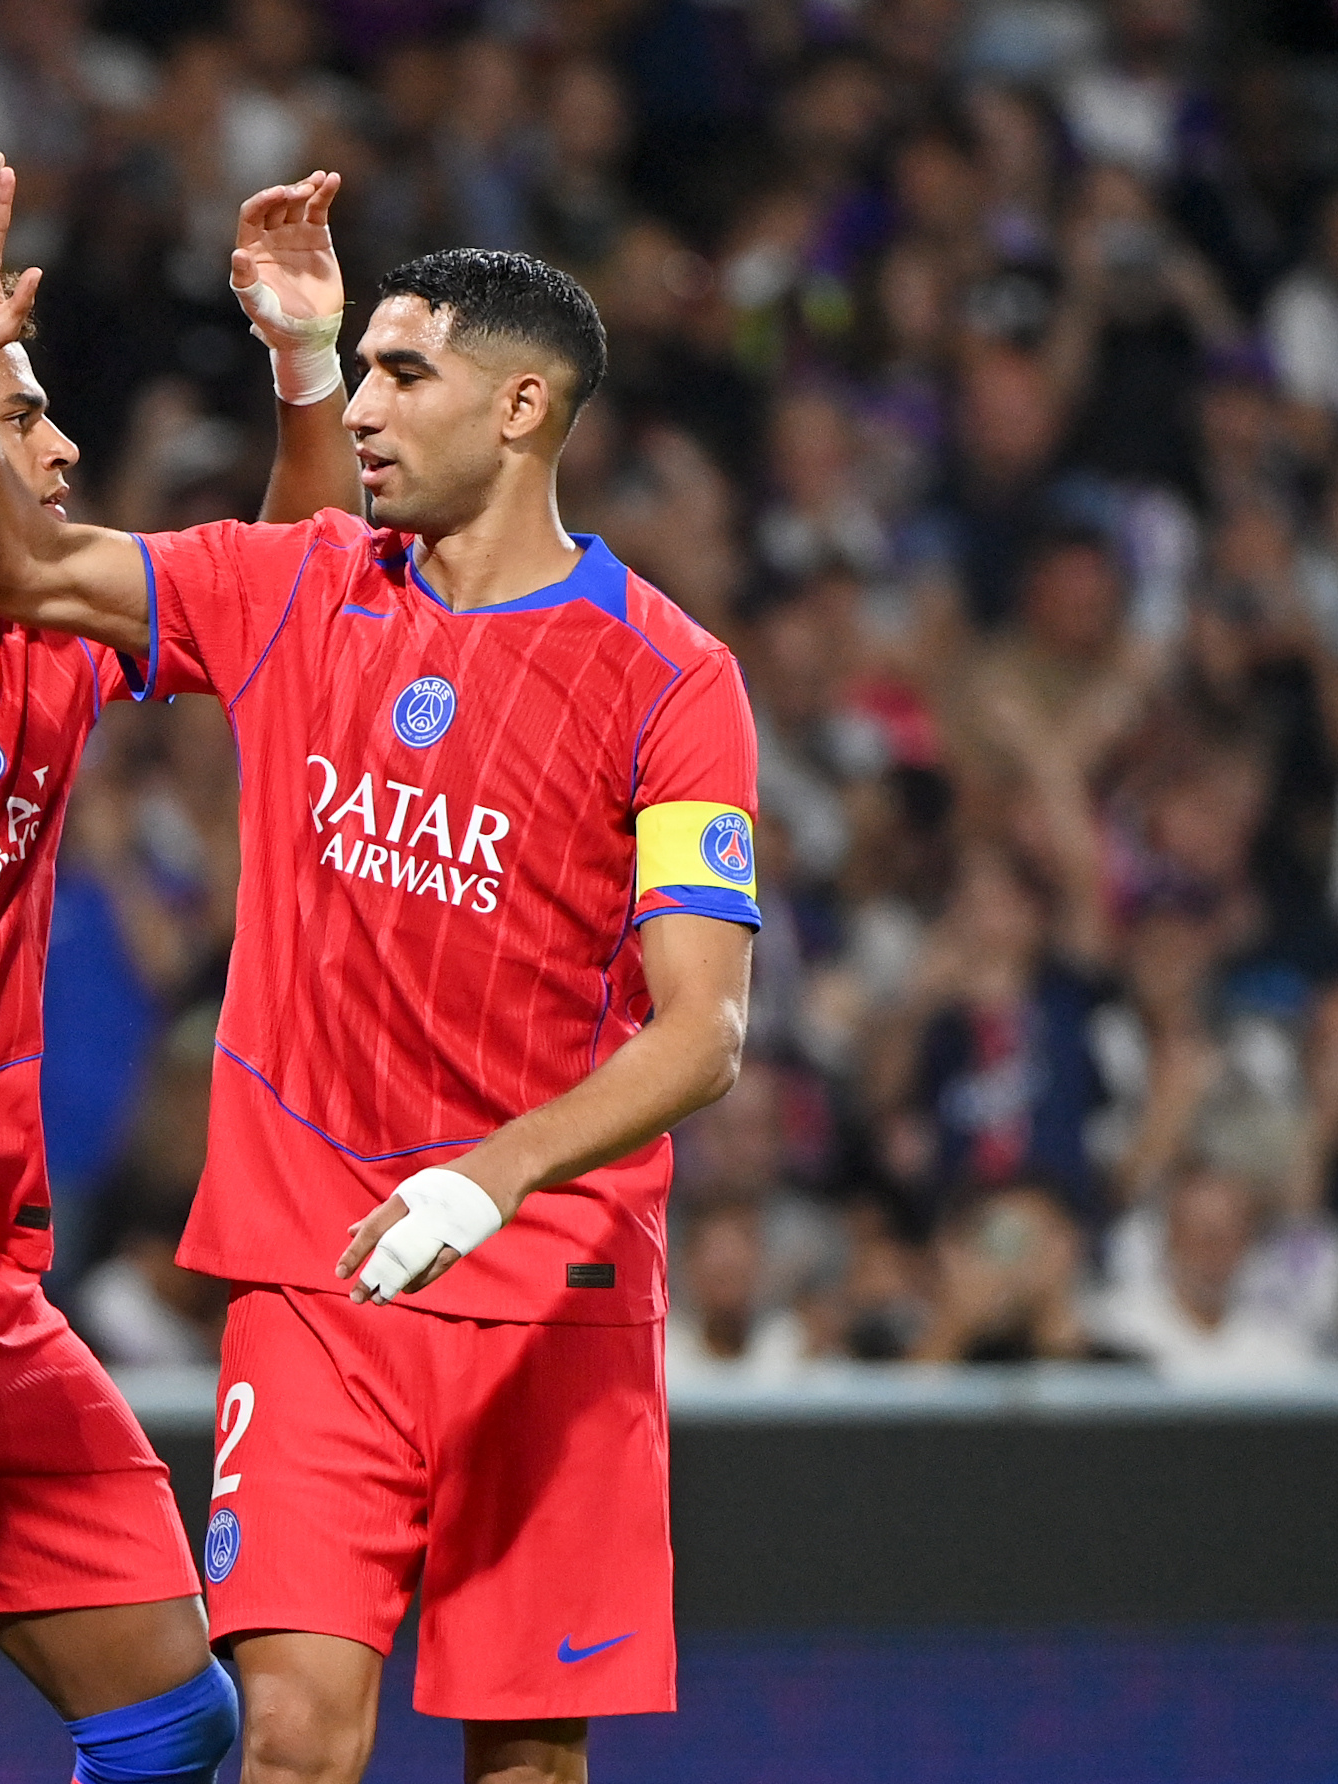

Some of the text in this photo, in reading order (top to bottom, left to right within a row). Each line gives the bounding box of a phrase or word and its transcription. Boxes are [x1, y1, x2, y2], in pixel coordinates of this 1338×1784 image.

[413, 681, 450, 701] PARIS
[715, 818, 749, 841] PARIS
[320, 832, 500, 913] AIRWAYS
[211, 1381, 255, 1501] 2
[210, 1513, 233, 1534] PARIS
